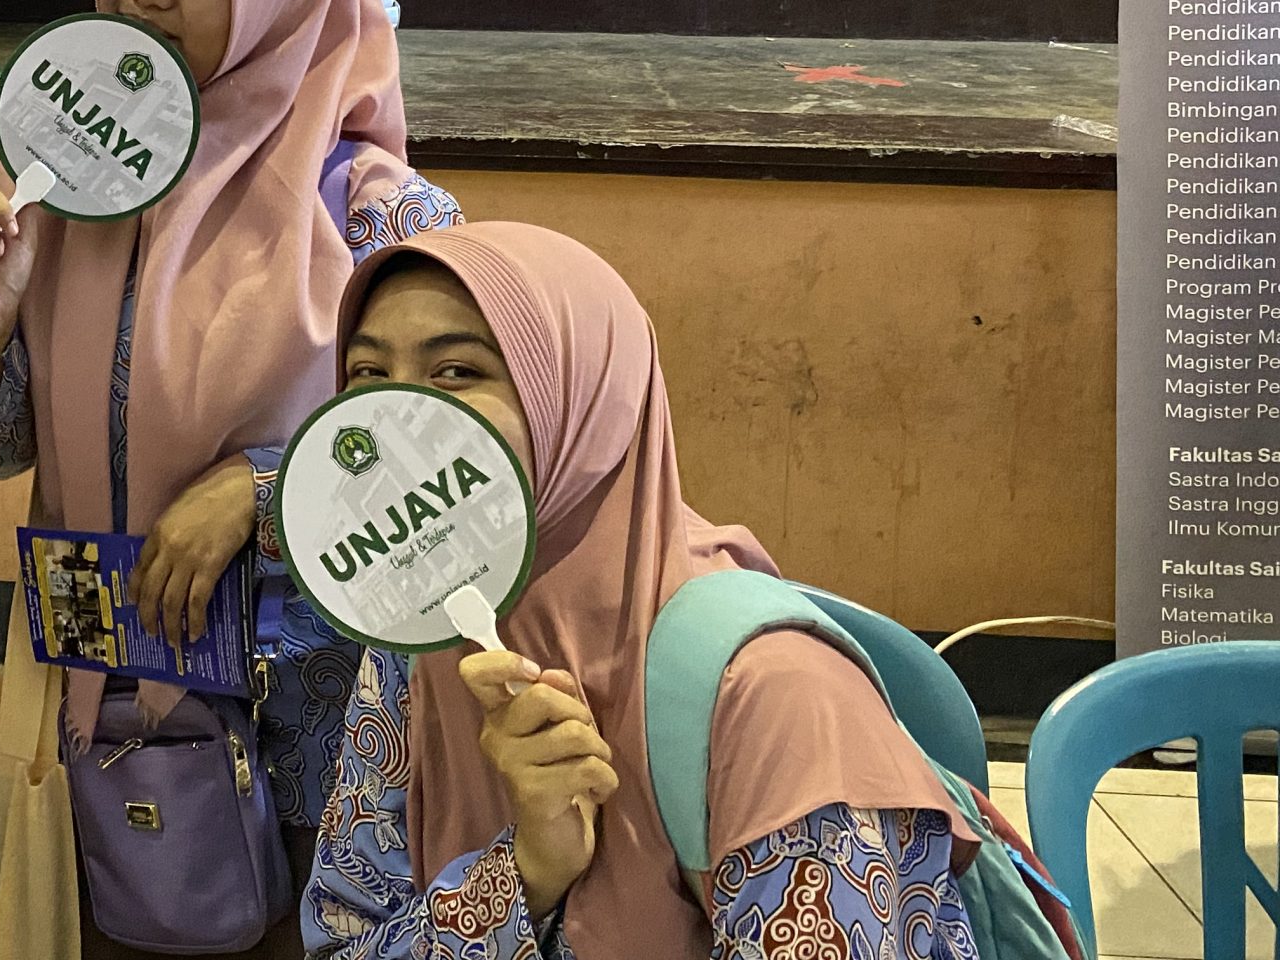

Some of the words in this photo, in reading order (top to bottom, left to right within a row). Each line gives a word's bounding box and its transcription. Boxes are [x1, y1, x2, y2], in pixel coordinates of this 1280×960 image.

[1168, 24, 1280, 41] Pendidikan
[1168, 49, 1280, 67] Pendidikan
[1168, 75, 1280, 92] Pendidikan
[1167, 101, 1277, 121] Bimbingan
[31, 59, 153, 181] UNJAYA
[1167, 127, 1279, 144] Pendidikan
[1167, 152, 1278, 169] Pendidikan
[1167, 178, 1277, 194] Pendidikan
[1166, 203, 1277, 220] Pendidikan
[1166, 228, 1276, 245] Pendidikan
[1166, 253, 1276, 270] Pendidikan
[1166, 279, 1252, 298] Program
[1166, 304, 1252, 323] Magister
[1259, 304, 1280, 320] Pe
[1166, 329, 1252, 348] Magister
[1165, 353, 1252, 373] Magister
[1258, 354, 1280, 370] Pe
[1165, 378, 1251, 398] Magister
[1257, 379, 1280, 394] Pe
[1165, 403, 1251, 422] Magister
[1257, 403, 1280, 419] Pe
[1169, 447, 1253, 463] Fakultas
[1168, 471, 1229, 487] Sastra
[1236, 471, 1279, 488] Indo
[1168, 495, 1229, 512] Sastra
[1236, 496, 1279, 516] Ingg
[319, 456, 492, 583] UNJAYA
[1168, 520, 1210, 536] Ilmu
[416, 539, 427, 552] &
[1161, 559, 1245, 576] Fakultas
[1161, 583, 1214, 599] Fisika
[1161, 607, 1274, 624] Matematika
